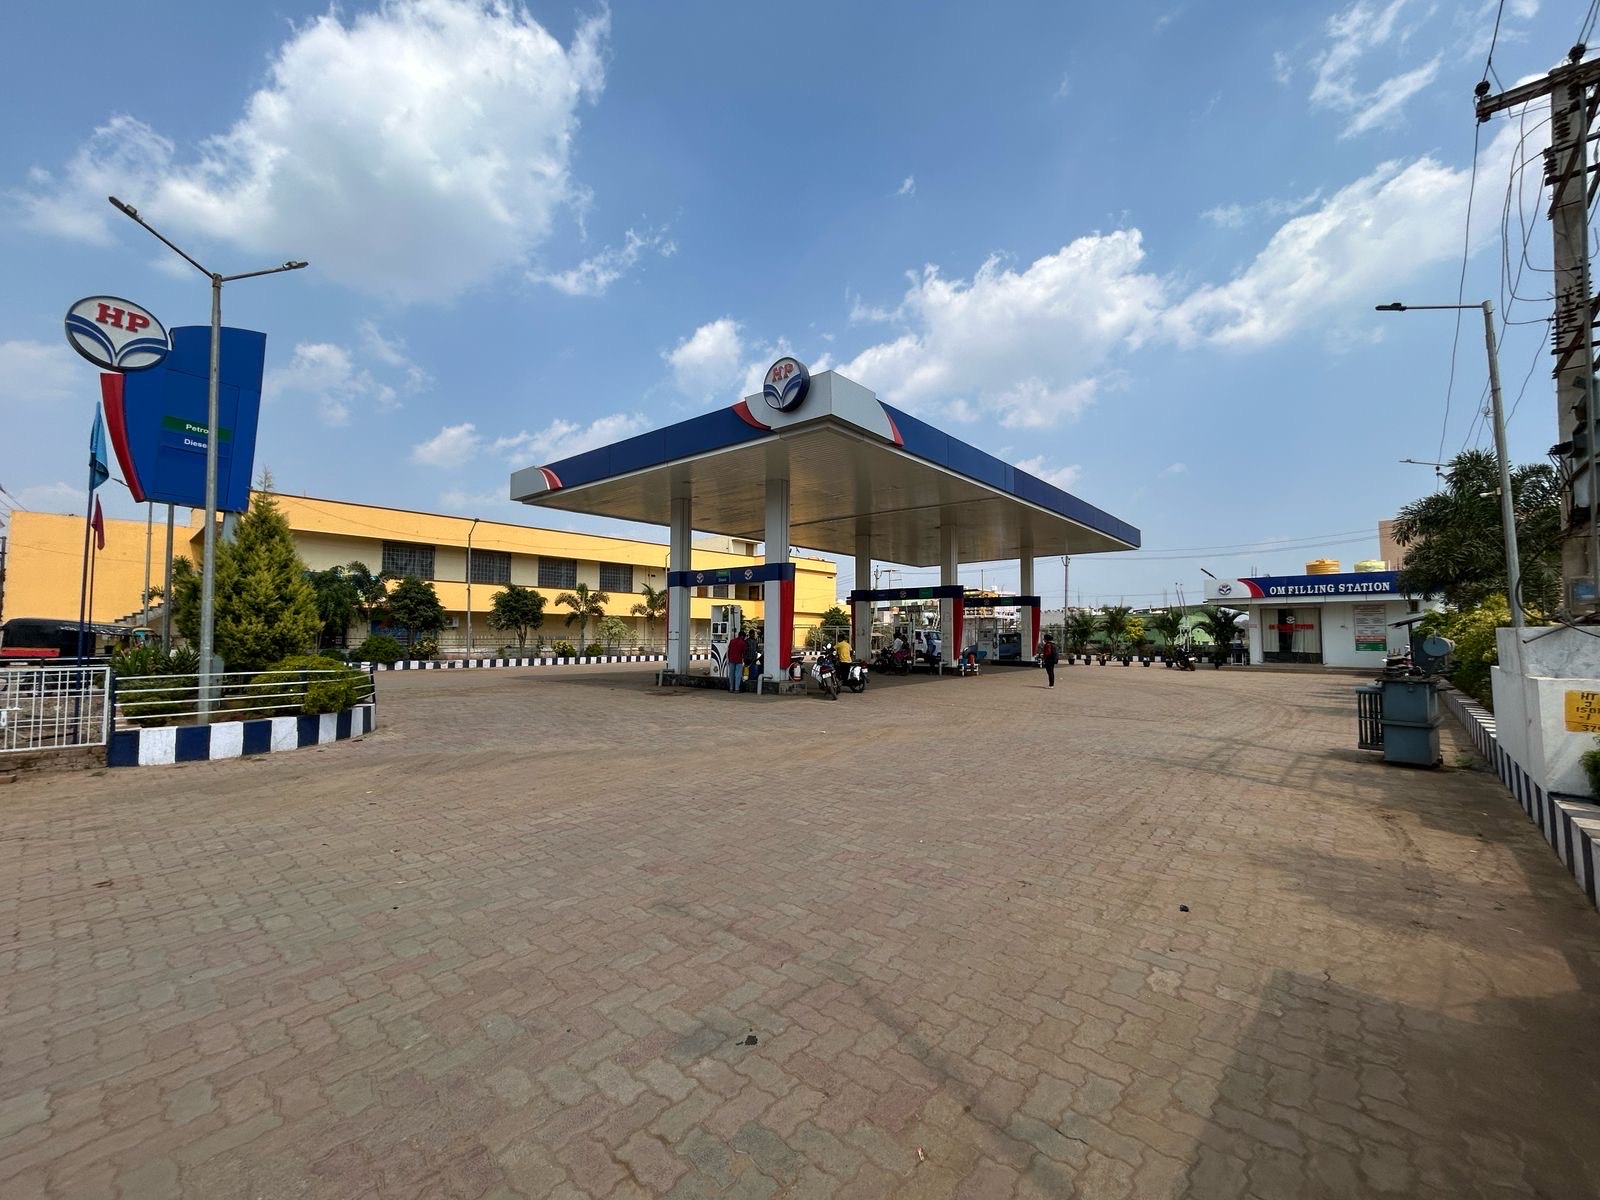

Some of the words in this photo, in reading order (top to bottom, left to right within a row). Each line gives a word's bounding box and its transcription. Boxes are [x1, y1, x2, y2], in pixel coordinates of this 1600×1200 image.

[96, 302, 150, 333] HP
[772, 363, 793, 382] HP
[185, 423, 209, 434] Petro
[184, 438, 208, 449] Diese
[1269, 586, 1286, 595] OM
[1287, 584, 1335, 594] FILLING
[1338, 582, 1390, 593] STATION
